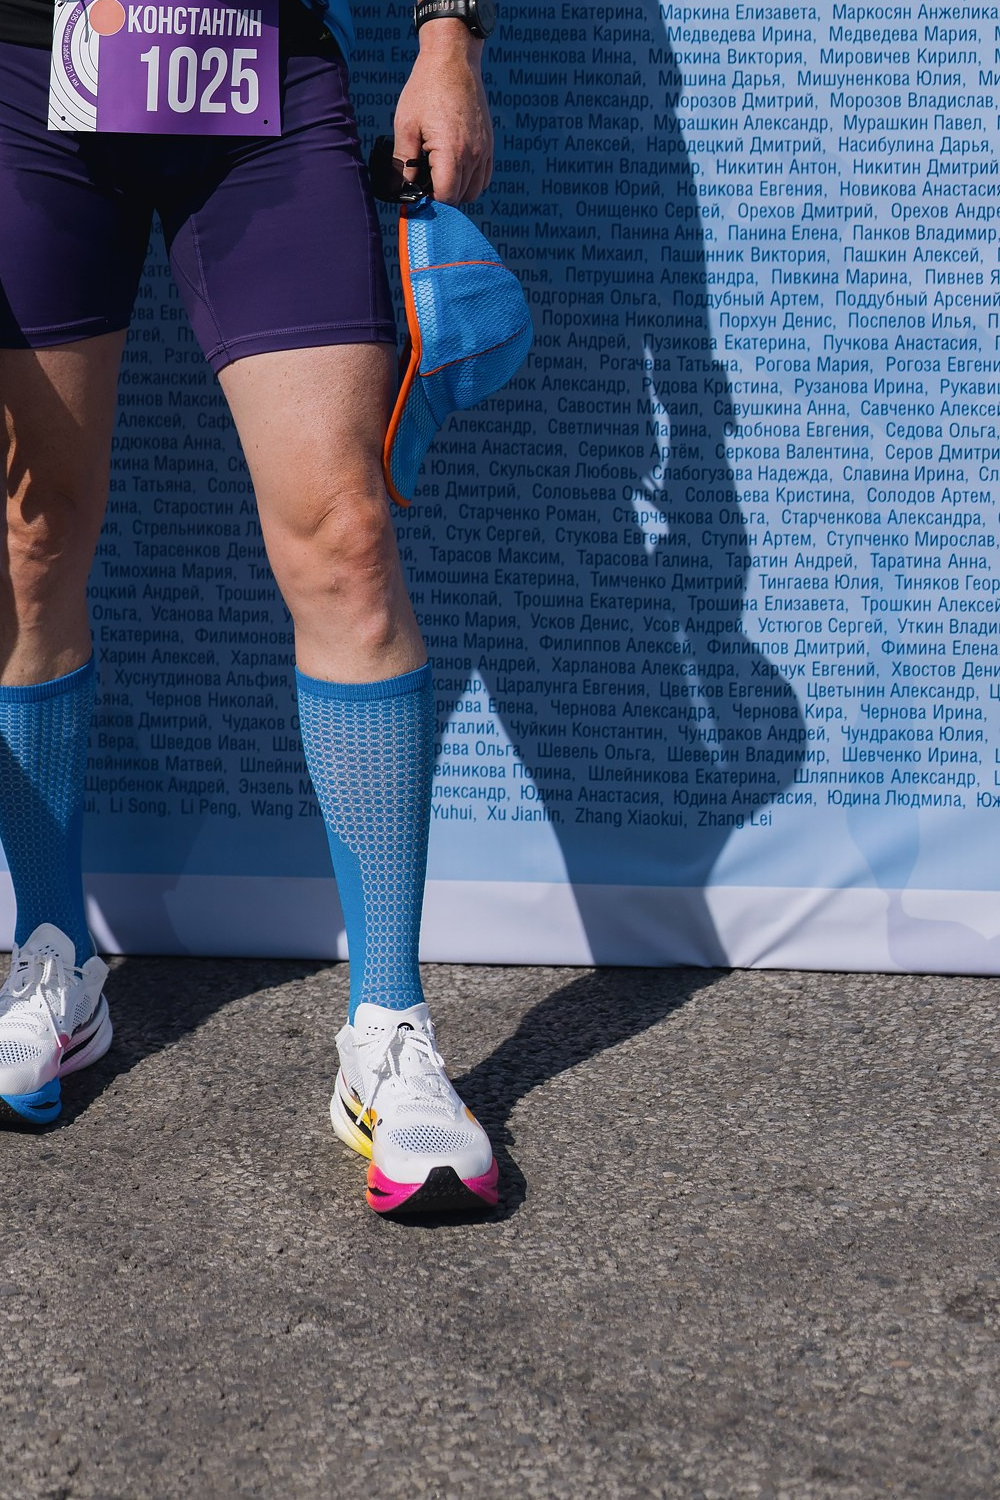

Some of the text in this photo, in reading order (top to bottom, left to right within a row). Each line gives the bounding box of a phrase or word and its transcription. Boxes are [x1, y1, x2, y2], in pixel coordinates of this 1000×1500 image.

[128, 5, 262, 37] КОНСТАНТИН
[141, 46, 260, 114] 1025
[717, 159, 920, 176] Никитин Антон, Никитин
[673, 291, 927, 309] Поддубный Артем, Поддубный
[751, 661, 955, 679] Харчук Евгений, Хвостов
[110, 797, 292, 820] Li Song, Li Peng, Wang
[488, 806, 771, 829] Xu Jianlin, Zhang Xiaokui, Zhang Lei
